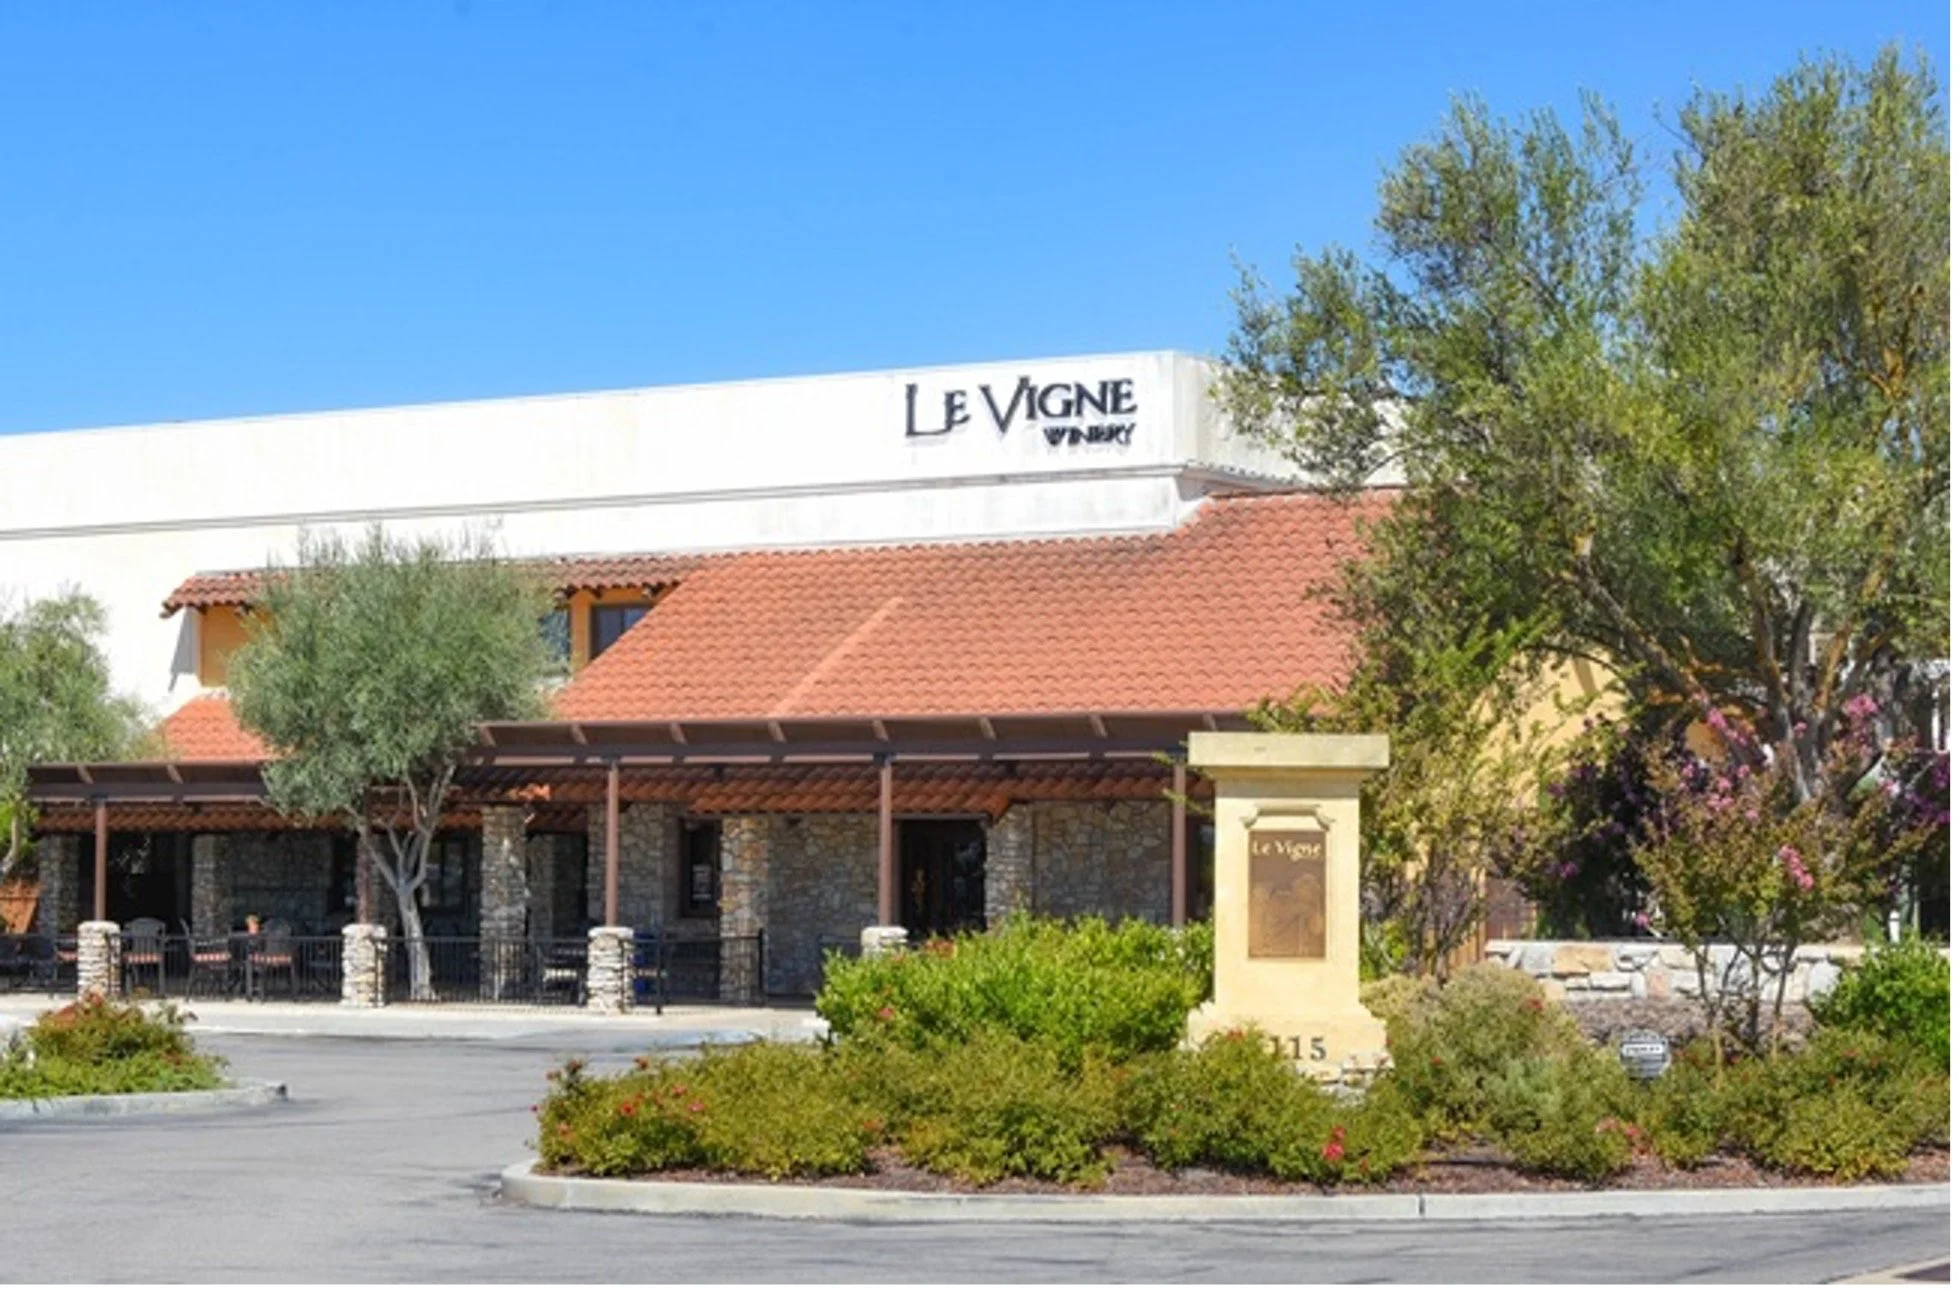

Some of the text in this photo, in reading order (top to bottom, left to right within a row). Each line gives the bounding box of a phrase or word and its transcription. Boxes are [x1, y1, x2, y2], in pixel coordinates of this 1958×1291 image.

[905, 375, 1138, 436] LE VIGNE
[1043, 423, 1136, 446] WINERY
[1252, 839, 1321, 861] Le Vigne
